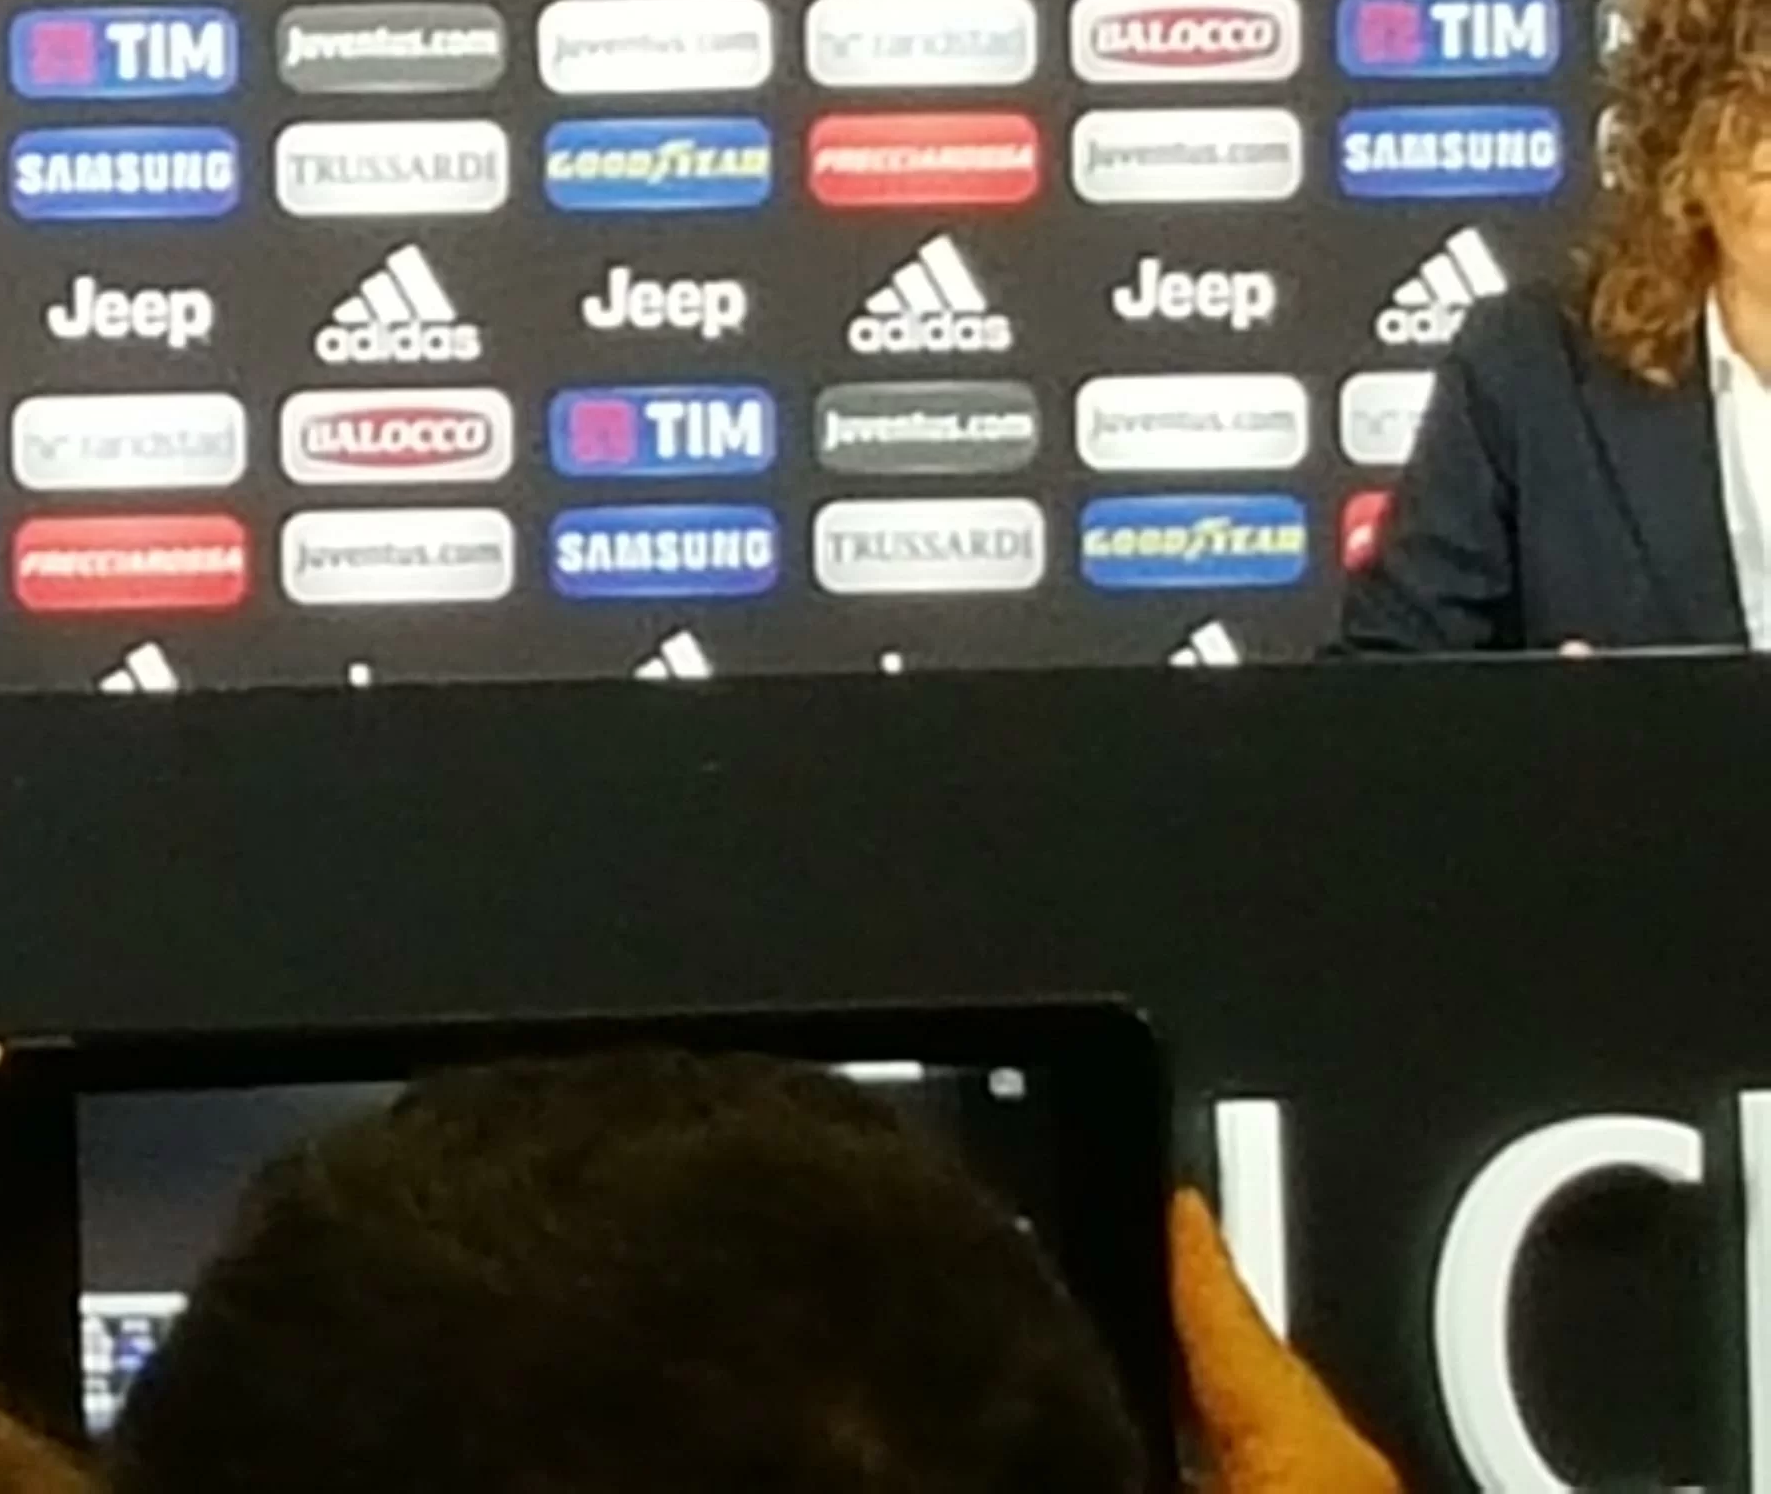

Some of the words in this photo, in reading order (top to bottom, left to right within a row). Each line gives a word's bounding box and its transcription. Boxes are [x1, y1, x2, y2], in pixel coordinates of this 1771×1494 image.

[107, 23, 225, 80] TIM
[1095, 18, 1273, 52] BALOCCO
[1431, 3, 1546, 59] TIM
[16, 152, 232, 196] SAMSUNG
[288, 151, 499, 186] TRUSSARDI
[547, 139, 771, 186] GOODYEAR
[1345, 131, 1556, 173] SAMSUNG
[47, 276, 214, 348] Jeep
[582, 268, 747, 338] Jeep
[1113, 259, 1277, 329] Jeep
[314, 318, 483, 362] adidas
[848, 310, 1014, 353] adidas
[305, 418, 487, 453] BALOCCO
[647, 401, 764, 457] TIM
[557, 529, 771, 571] SAMSUNG
[827, 528, 1034, 561] TRUSSARDI
[1083, 516, 1307, 560] GOODYEAR
